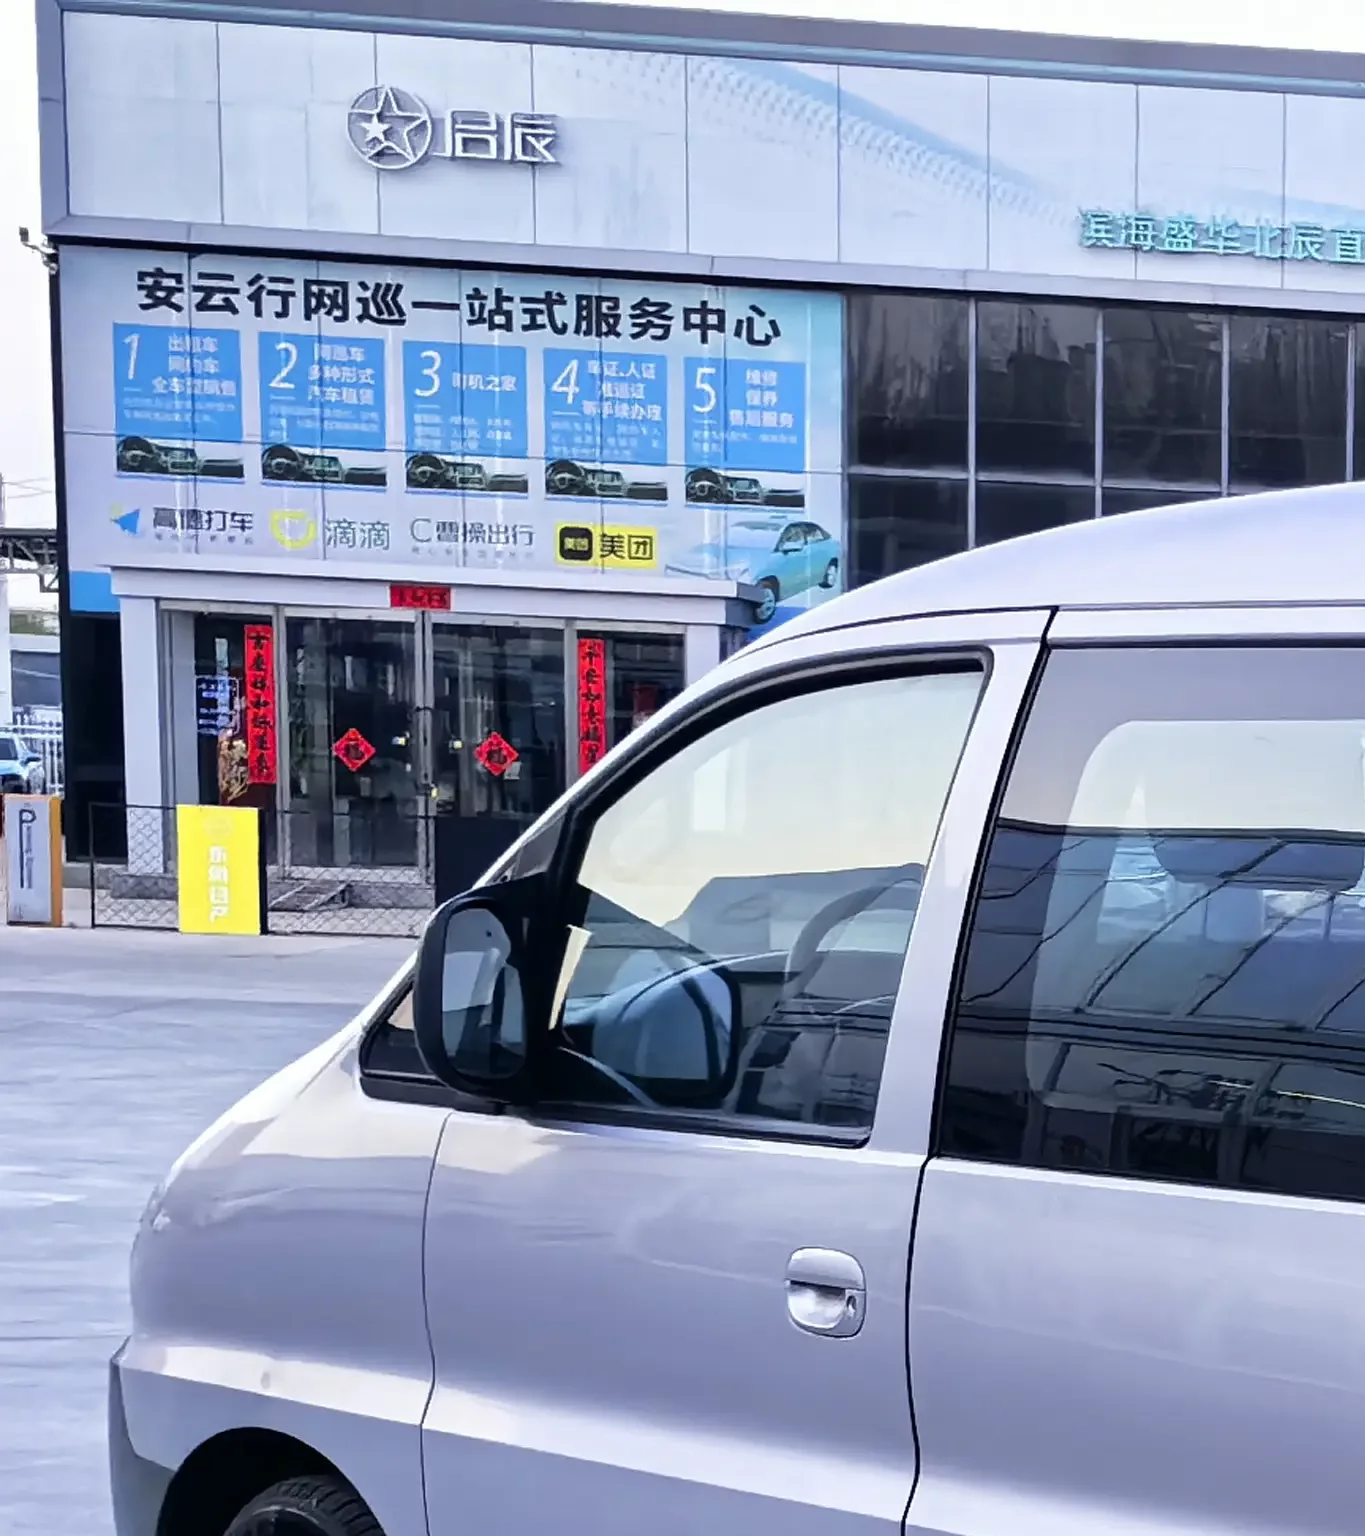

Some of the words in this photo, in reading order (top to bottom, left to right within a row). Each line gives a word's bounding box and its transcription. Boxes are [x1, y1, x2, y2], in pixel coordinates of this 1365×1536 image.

[432, 108, 560, 163] 启辰
[136, 267, 781, 347] 安云行网巡一站式服务中心
[123, 333, 140, 380] 1
[268, 342, 297, 389] 2
[414, 350, 441, 397] 3
[551, 359, 580, 404] 4
[693, 367, 716, 413] 5
[325, 518, 390, 550] 滴滴
[599, 533, 654, 560] 美团
